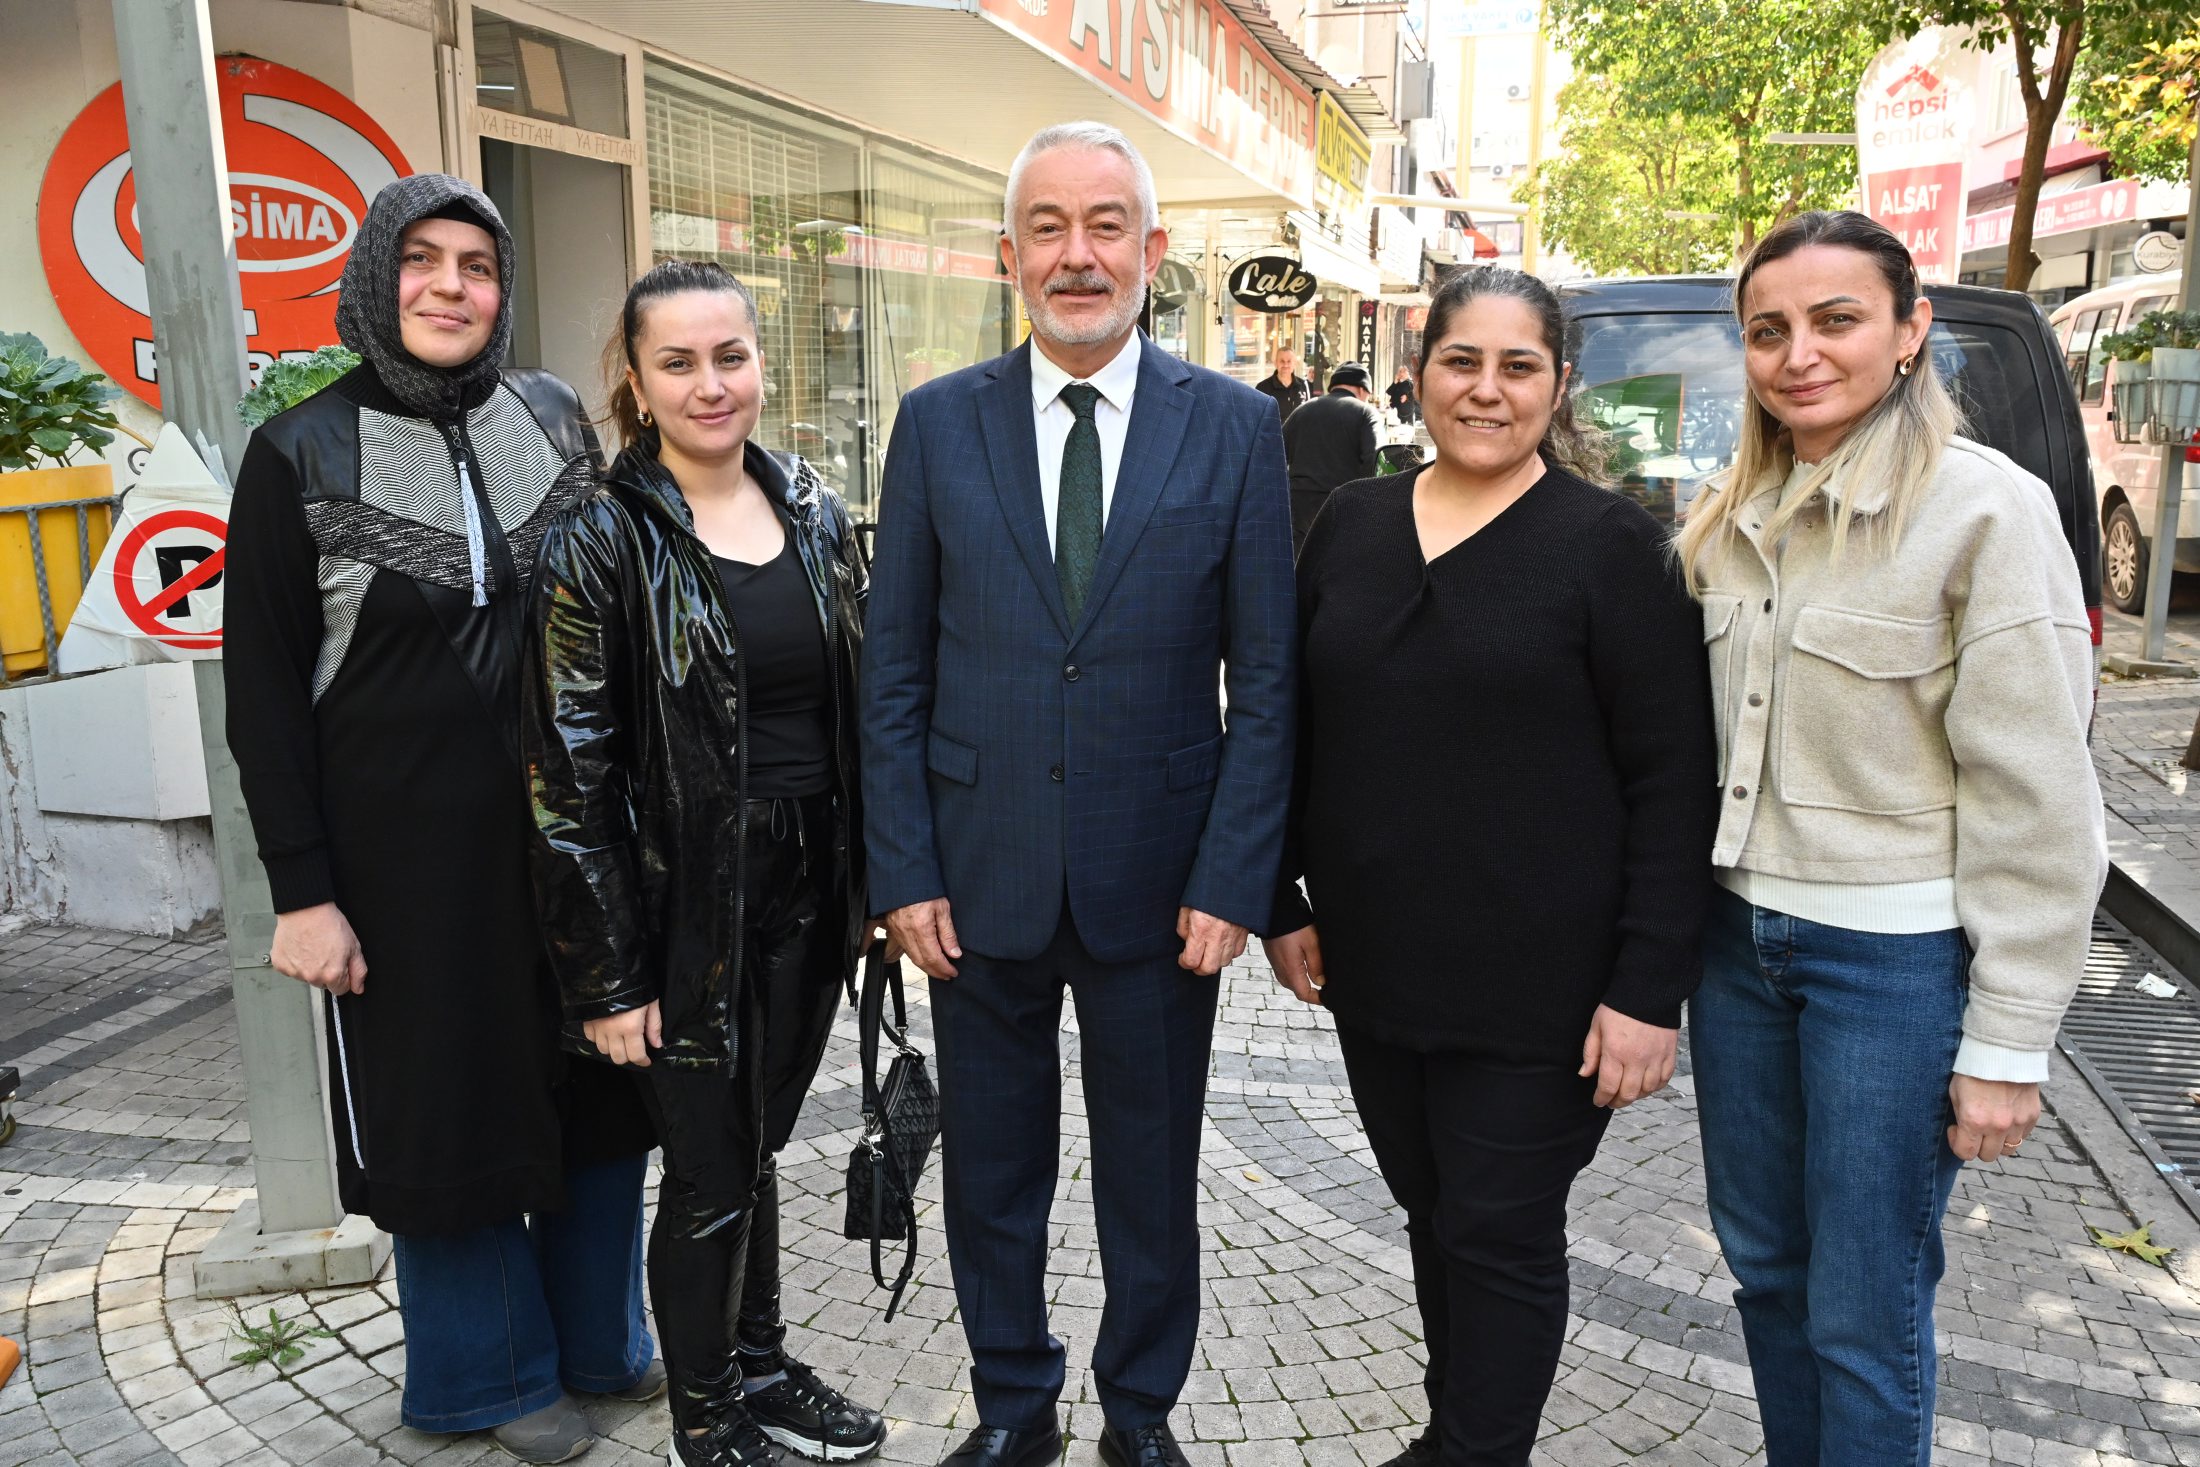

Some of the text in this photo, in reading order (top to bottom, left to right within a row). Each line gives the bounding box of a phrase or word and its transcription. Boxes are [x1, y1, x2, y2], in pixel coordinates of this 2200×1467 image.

[1239, 42, 1309, 186] PERDE
[1875, 88, 1948, 122] hepsi
[481, 112, 554, 146] YA FETTAH
[576, 131, 638, 161] YA FETTAH
[1873, 121, 1956, 148] emlak
[231, 191, 339, 242] SİMA
[1880, 184, 1942, 217] ALSAT
[1897, 226, 1939, 254] LAK
[1233, 262, 1311, 297] Lale
[1361, 316, 1372, 369] MATMAZ
